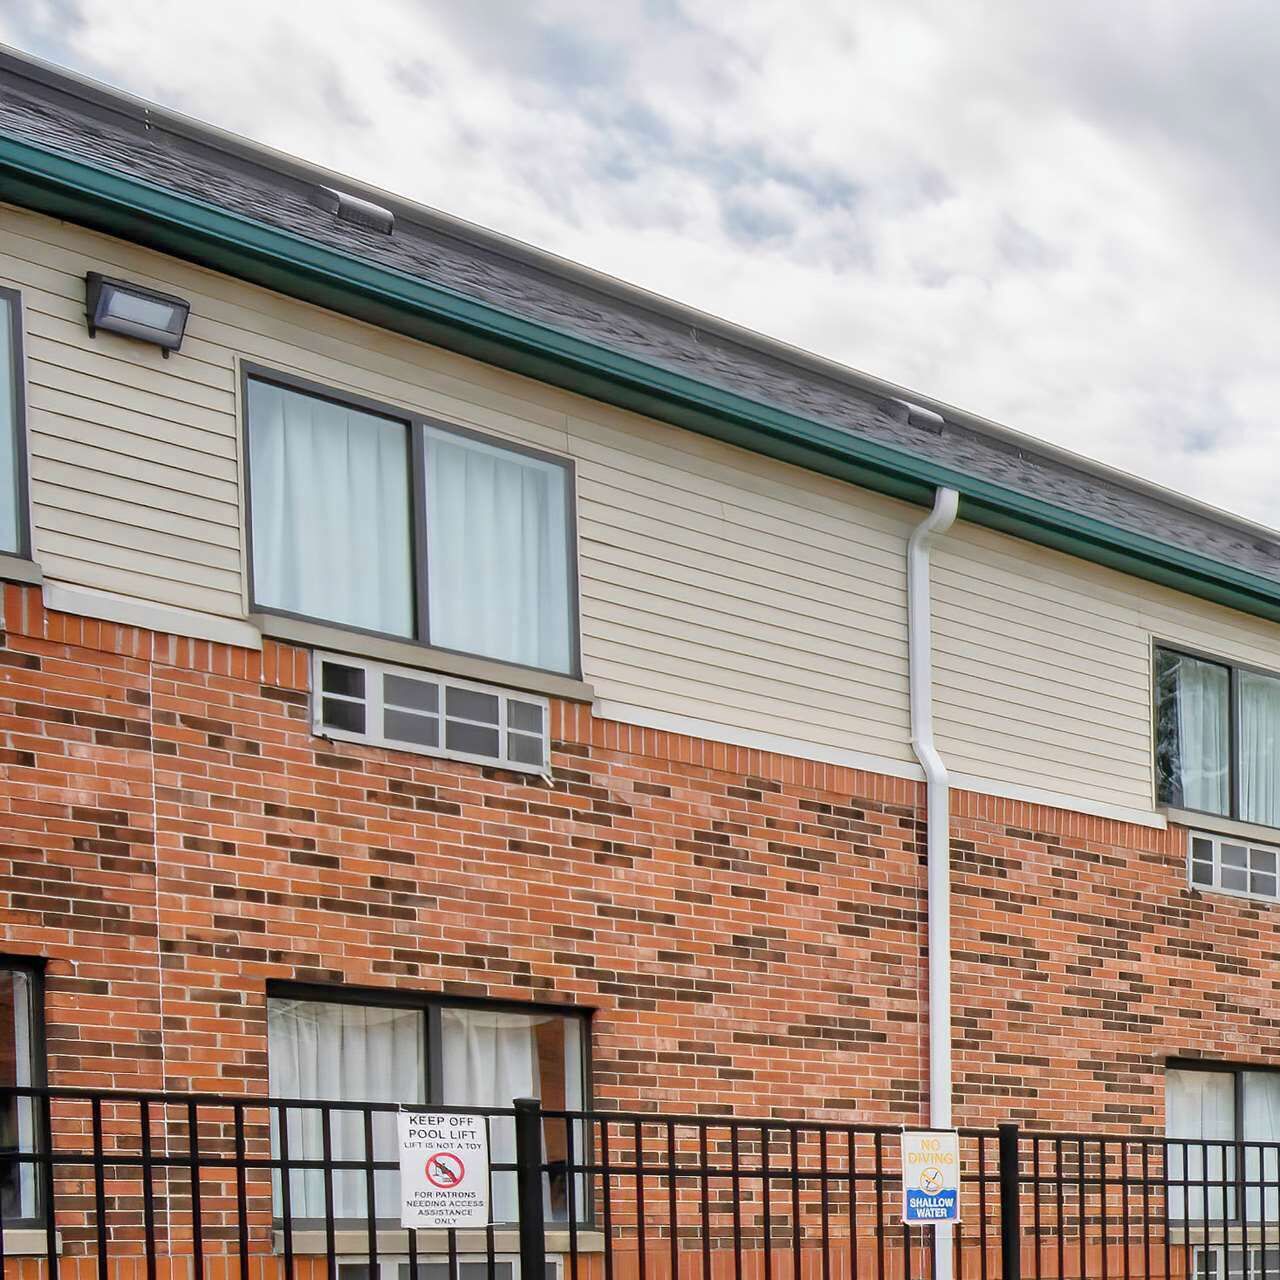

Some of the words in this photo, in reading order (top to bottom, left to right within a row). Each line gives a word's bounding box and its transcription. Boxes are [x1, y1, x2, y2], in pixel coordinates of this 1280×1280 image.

[409, 1116, 445, 1126] KEEP
[449, 1117, 475, 1127] OFF
[409, 1129, 446, 1139] POOL
[450, 1130, 477, 1140] LIFT
[920, 1138, 940, 1150] NO
[908, 1152, 953, 1165] DIVING
[909, 1197, 954, 1208] SHALLOW
[916, 1208, 948, 1218] WATER
[434, 1217, 457, 1225] ONLY
